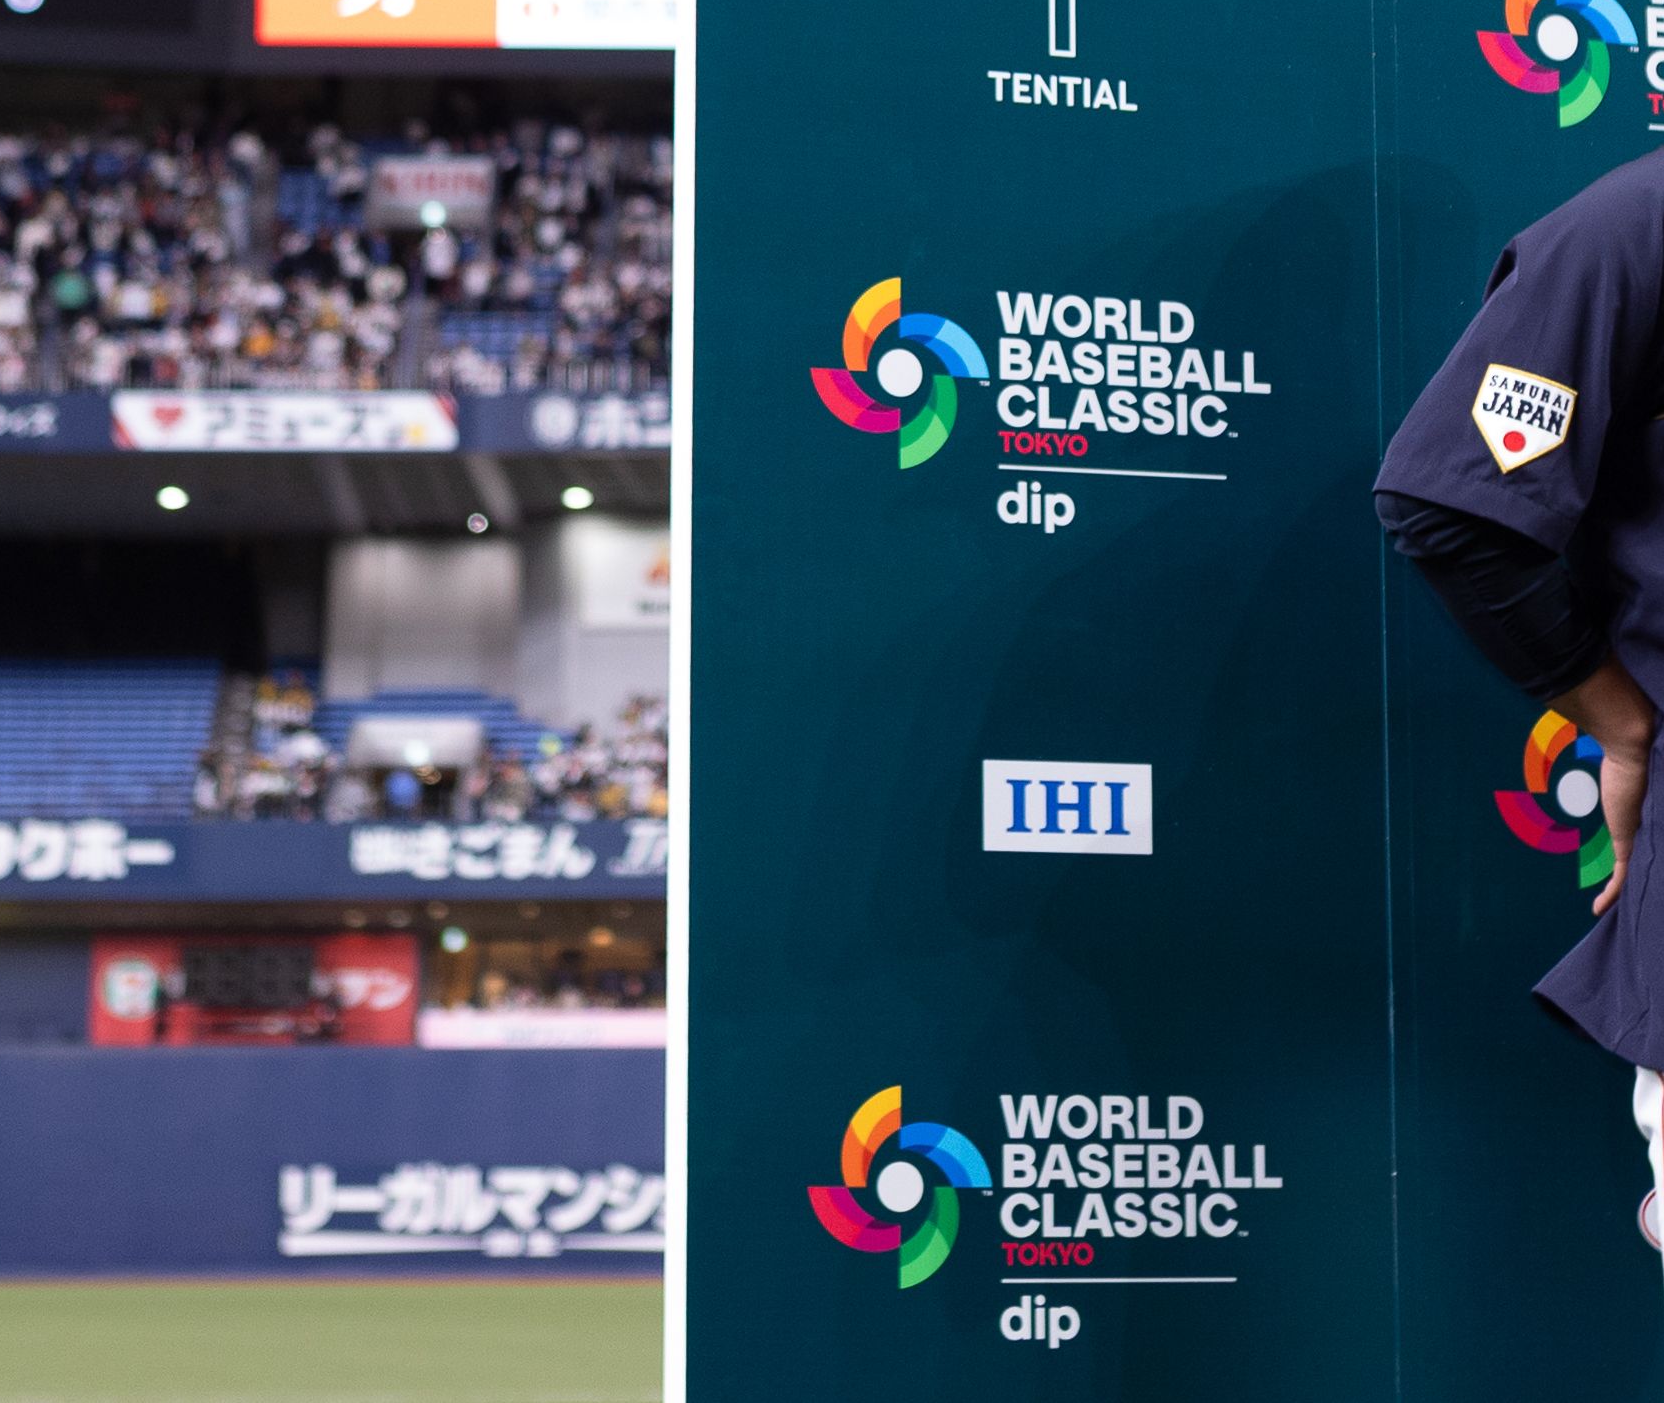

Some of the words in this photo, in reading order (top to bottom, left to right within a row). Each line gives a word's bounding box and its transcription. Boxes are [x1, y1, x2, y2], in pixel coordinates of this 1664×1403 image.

[987, 70, 1138, 112] TENTIAL
[997, 291, 1195, 343] WORLD
[998, 338, 1272, 395] BASEBALL
[997, 385, 1229, 438] CLASSIC
[1482, 392, 1566, 437] JAPAN
[1489, 374, 1570, 412] SAMURAI
[998, 431, 1089, 457] TOKYO
[997, 481, 1076, 534] dip
[1006, 779, 1130, 835] IHI
[1000, 1094, 1205, 1140] WORLD
[1002, 1144, 1283, 1189] BASEBALL
[279, 1162, 665, 1233] リーガルマンシ
[1000, 1193, 1239, 1238] CLASSIC
[1001, 1242, 1095, 1267] TOKYO
[1000, 1295, 1081, 1349] dip
